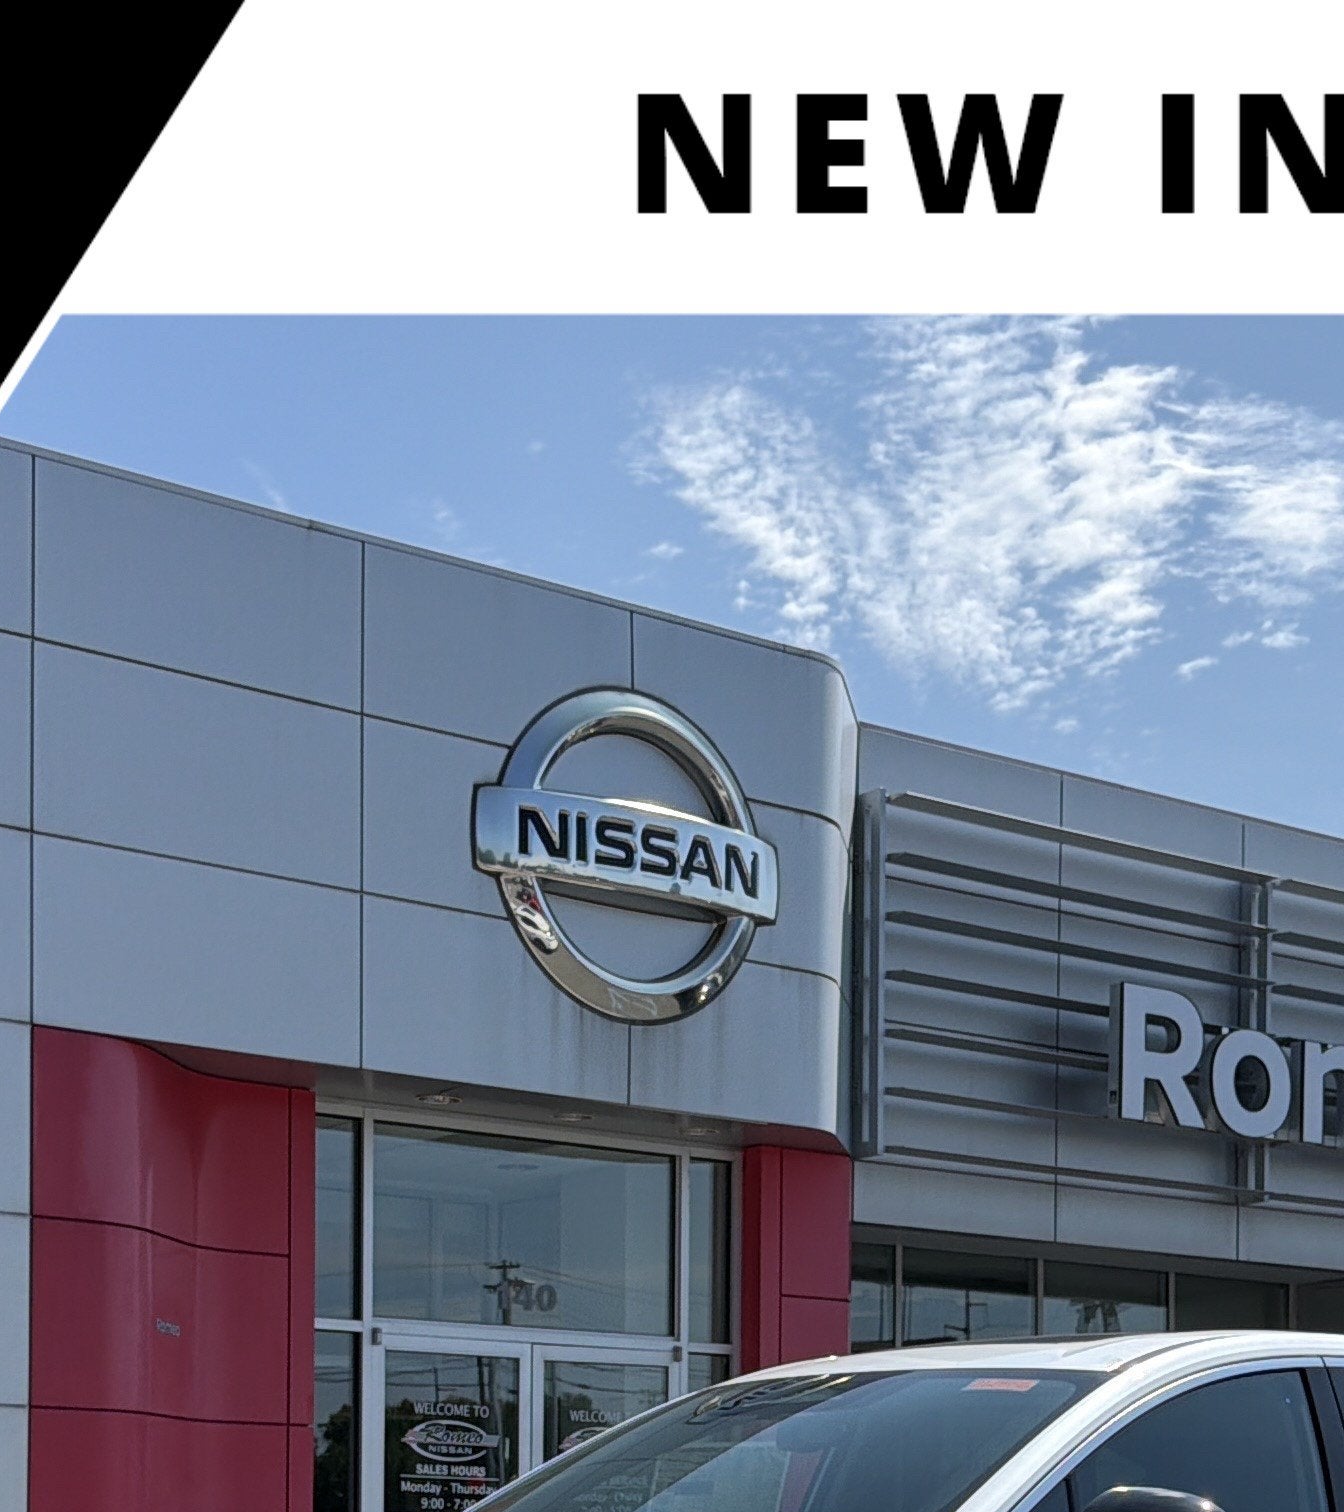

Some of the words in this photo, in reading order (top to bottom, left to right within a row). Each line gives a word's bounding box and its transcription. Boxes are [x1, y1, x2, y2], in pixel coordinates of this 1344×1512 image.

[519, 805, 758, 899] NISSAN
[414, 1401, 471, 1416] WELCOME
[473, 1405, 490, 1418] TO
[428, 1445, 473, 1455] NISSAN
[415, 1463, 448, 1475] SALES
[450, 1465, 486, 1477] HOURS
[400, 1480, 443, 1495] Monday
[421, 1498, 445, 1510] 9:00
